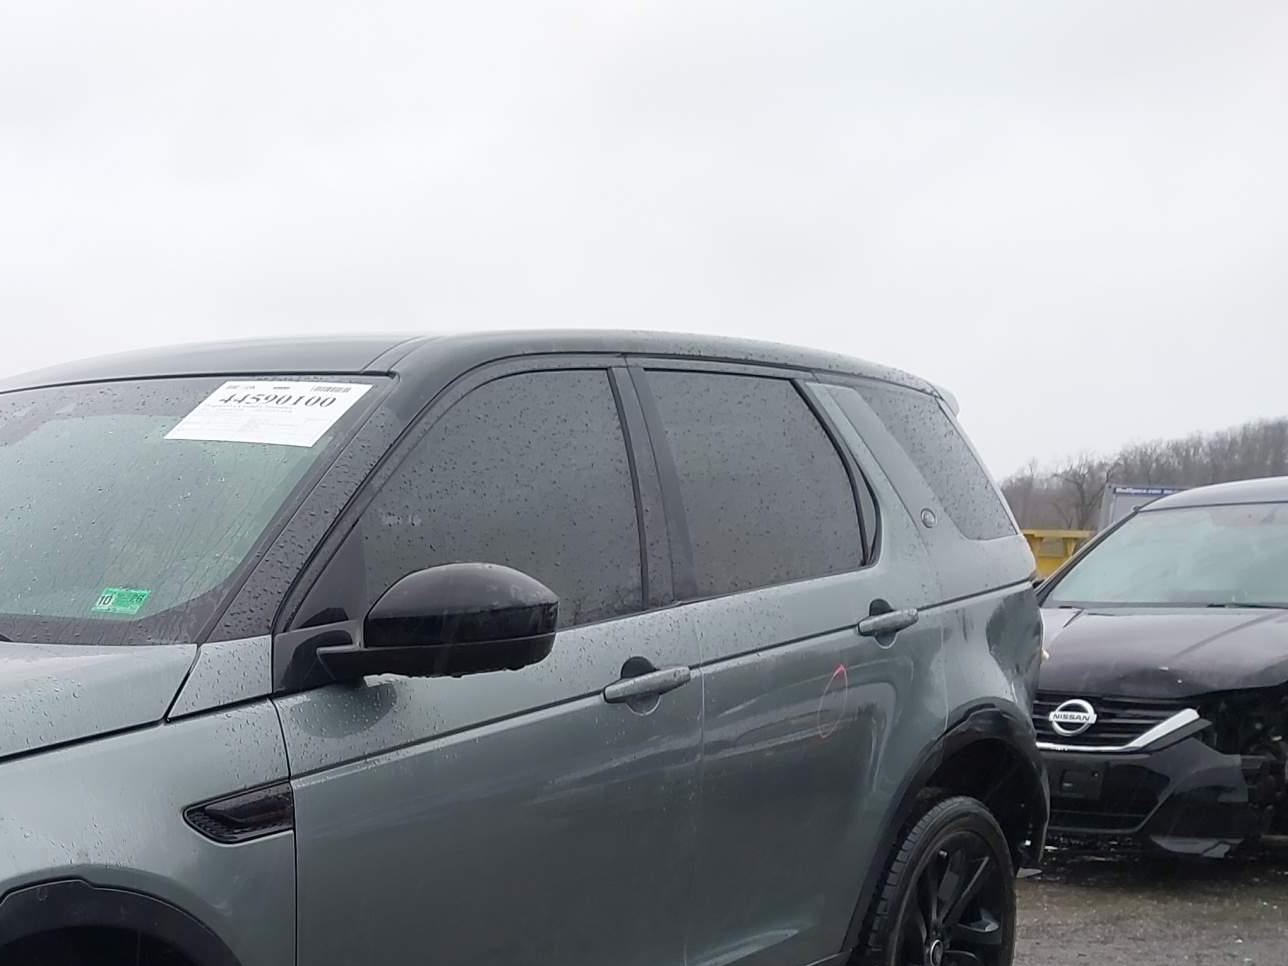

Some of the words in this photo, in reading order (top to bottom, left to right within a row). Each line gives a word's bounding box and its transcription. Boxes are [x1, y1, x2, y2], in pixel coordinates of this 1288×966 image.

[218, 393, 337, 408] 44590100
[98, 595, 113, 606] 10
[1052, 713, 1091, 721] NISSAN
